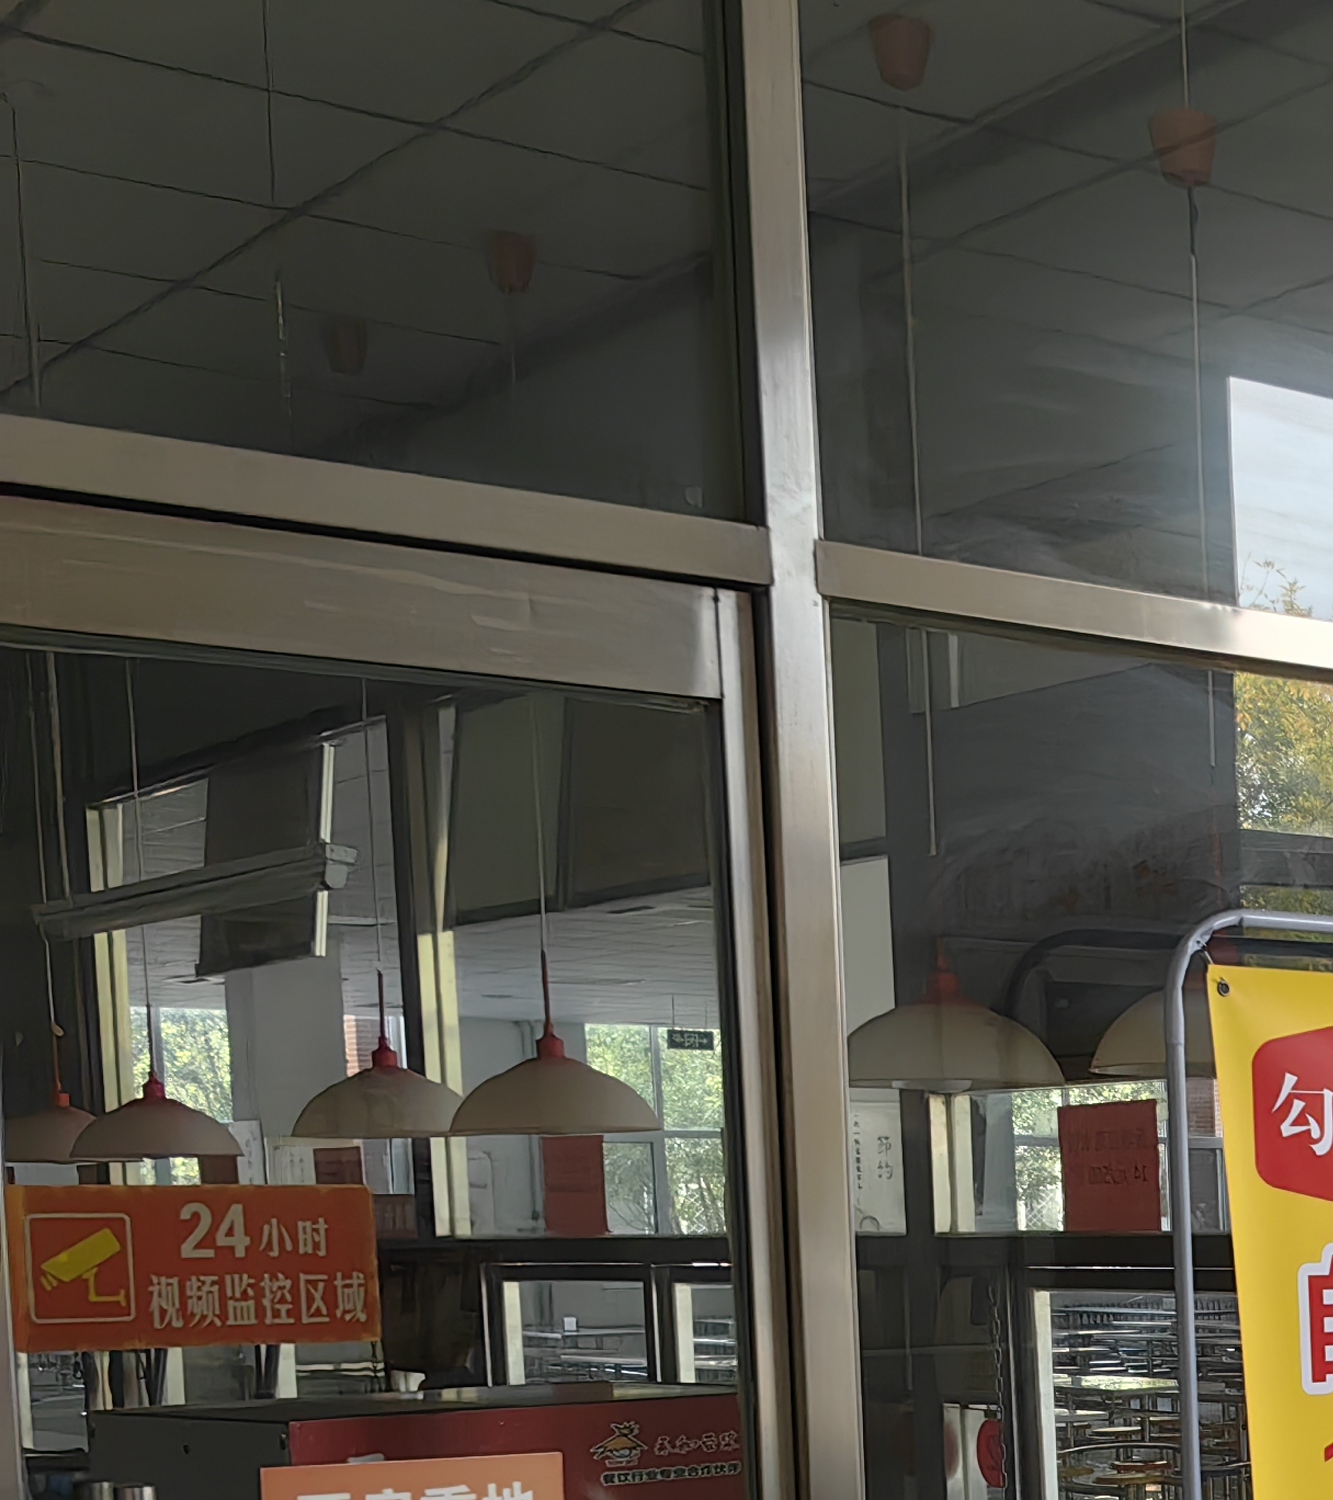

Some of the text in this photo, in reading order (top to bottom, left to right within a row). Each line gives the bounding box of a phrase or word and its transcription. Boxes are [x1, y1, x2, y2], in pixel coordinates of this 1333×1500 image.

[180, 1202, 329, 1259] 24小时
[148, 1271, 367, 1329] 视频监控区域
